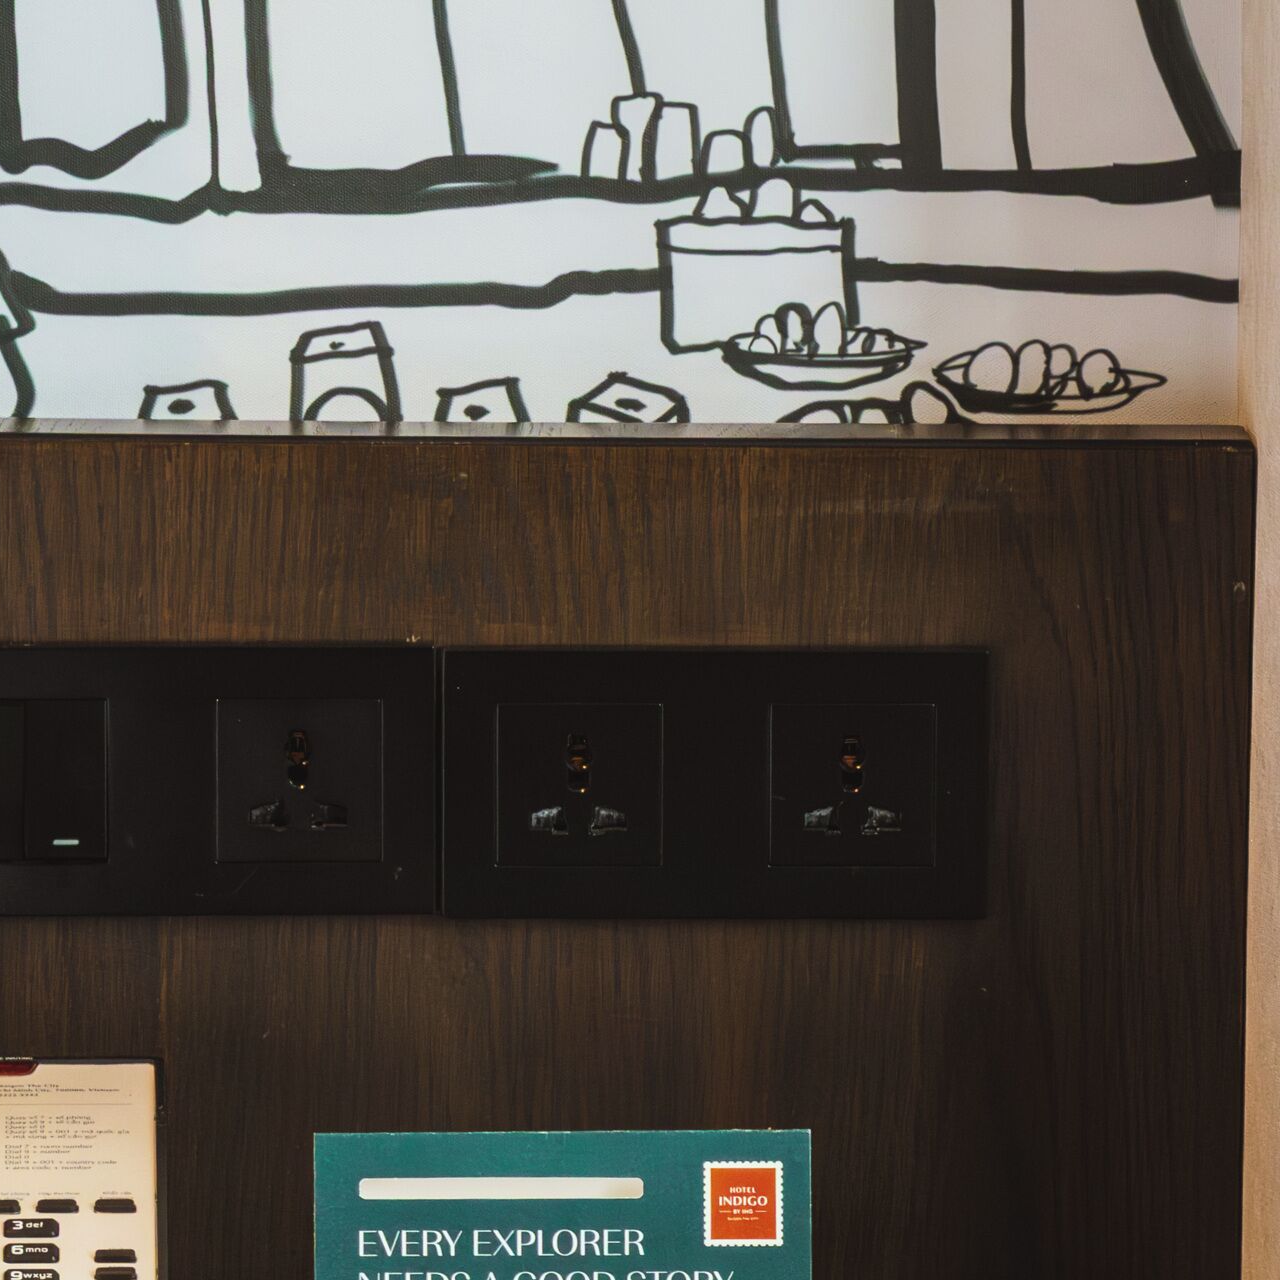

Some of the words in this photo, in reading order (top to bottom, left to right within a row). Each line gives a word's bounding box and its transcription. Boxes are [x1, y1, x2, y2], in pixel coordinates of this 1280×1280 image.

[729, 1186, 756, 1194] HOTEL
[719, 1196, 768, 1206] INDIGO
[12, 1221, 24, 1230] 3
[359, 1230, 462, 1256] EVERY
[473, 1229, 644, 1256] EXPLORER
[11, 1245, 23, 1255] 6
[10, 1271, 22, 1280] 9
[22, 1272, 53, 1280] wxyz
